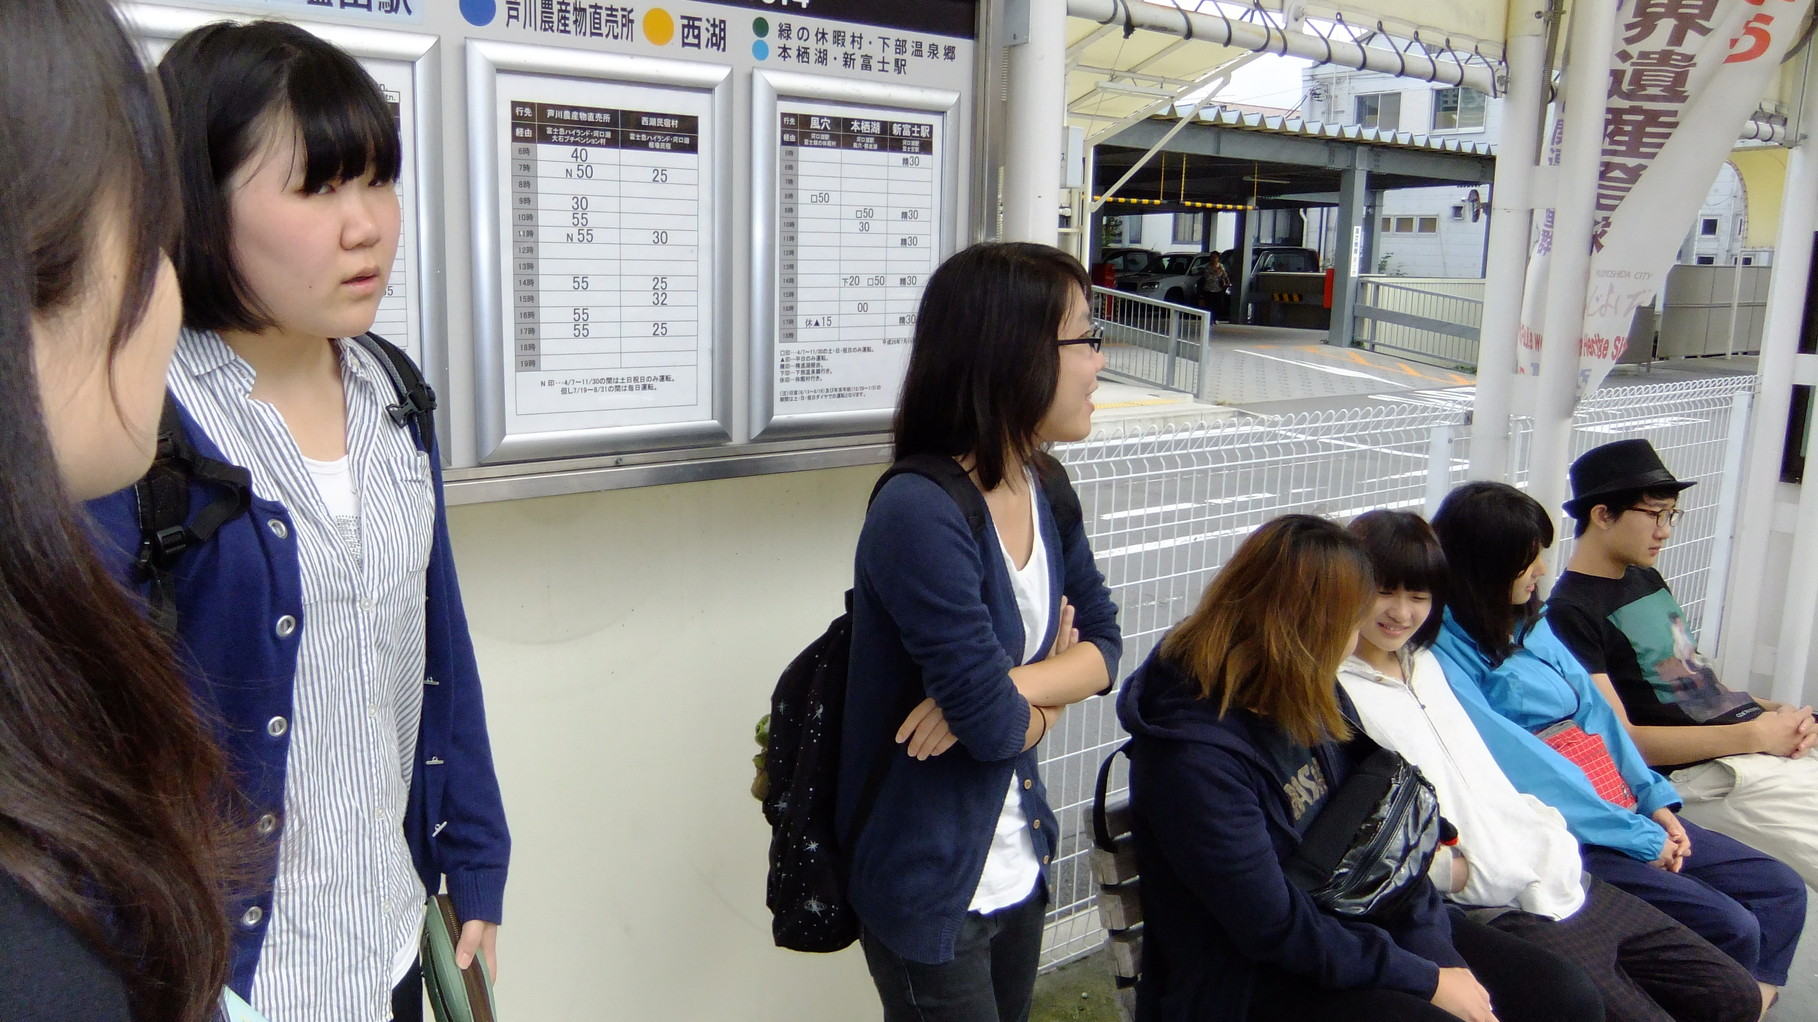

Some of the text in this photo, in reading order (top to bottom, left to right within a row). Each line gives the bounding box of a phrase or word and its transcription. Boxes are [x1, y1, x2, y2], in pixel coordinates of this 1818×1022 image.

[679, 14, 727, 52] 西湖
[777, 44, 907, 75] 本栖湖・新富士駅
[515, 107, 533, 117] 行先
[810, 116, 831, 130] 風穴
[850, 120, 881, 134] 本栖湖
[515, 128, 533, 138] 経由
[892, 123, 930, 138] 新富士駅
[571, 148, 588, 162] 40
[565, 164, 594, 179] N 50
[652, 168, 668, 183] 25
[571, 196, 589, 211] 30
[818, 193, 830, 204] 50
[572, 212, 589, 227] 55
[863, 208, 874, 219] 50
[859, 222, 870, 232] 30
[566, 229, 594, 243] N 55
[652, 231, 668, 245] 30
[572, 276, 589, 291] 55
[652, 276, 668, 291] 25
[874, 276, 885, 286] 50
[652, 292, 668, 306] 32
[573, 308, 590, 322] 55
[857, 303, 868, 313] 00
[573, 324, 590, 338] 55
[652, 322, 668, 336] 25
